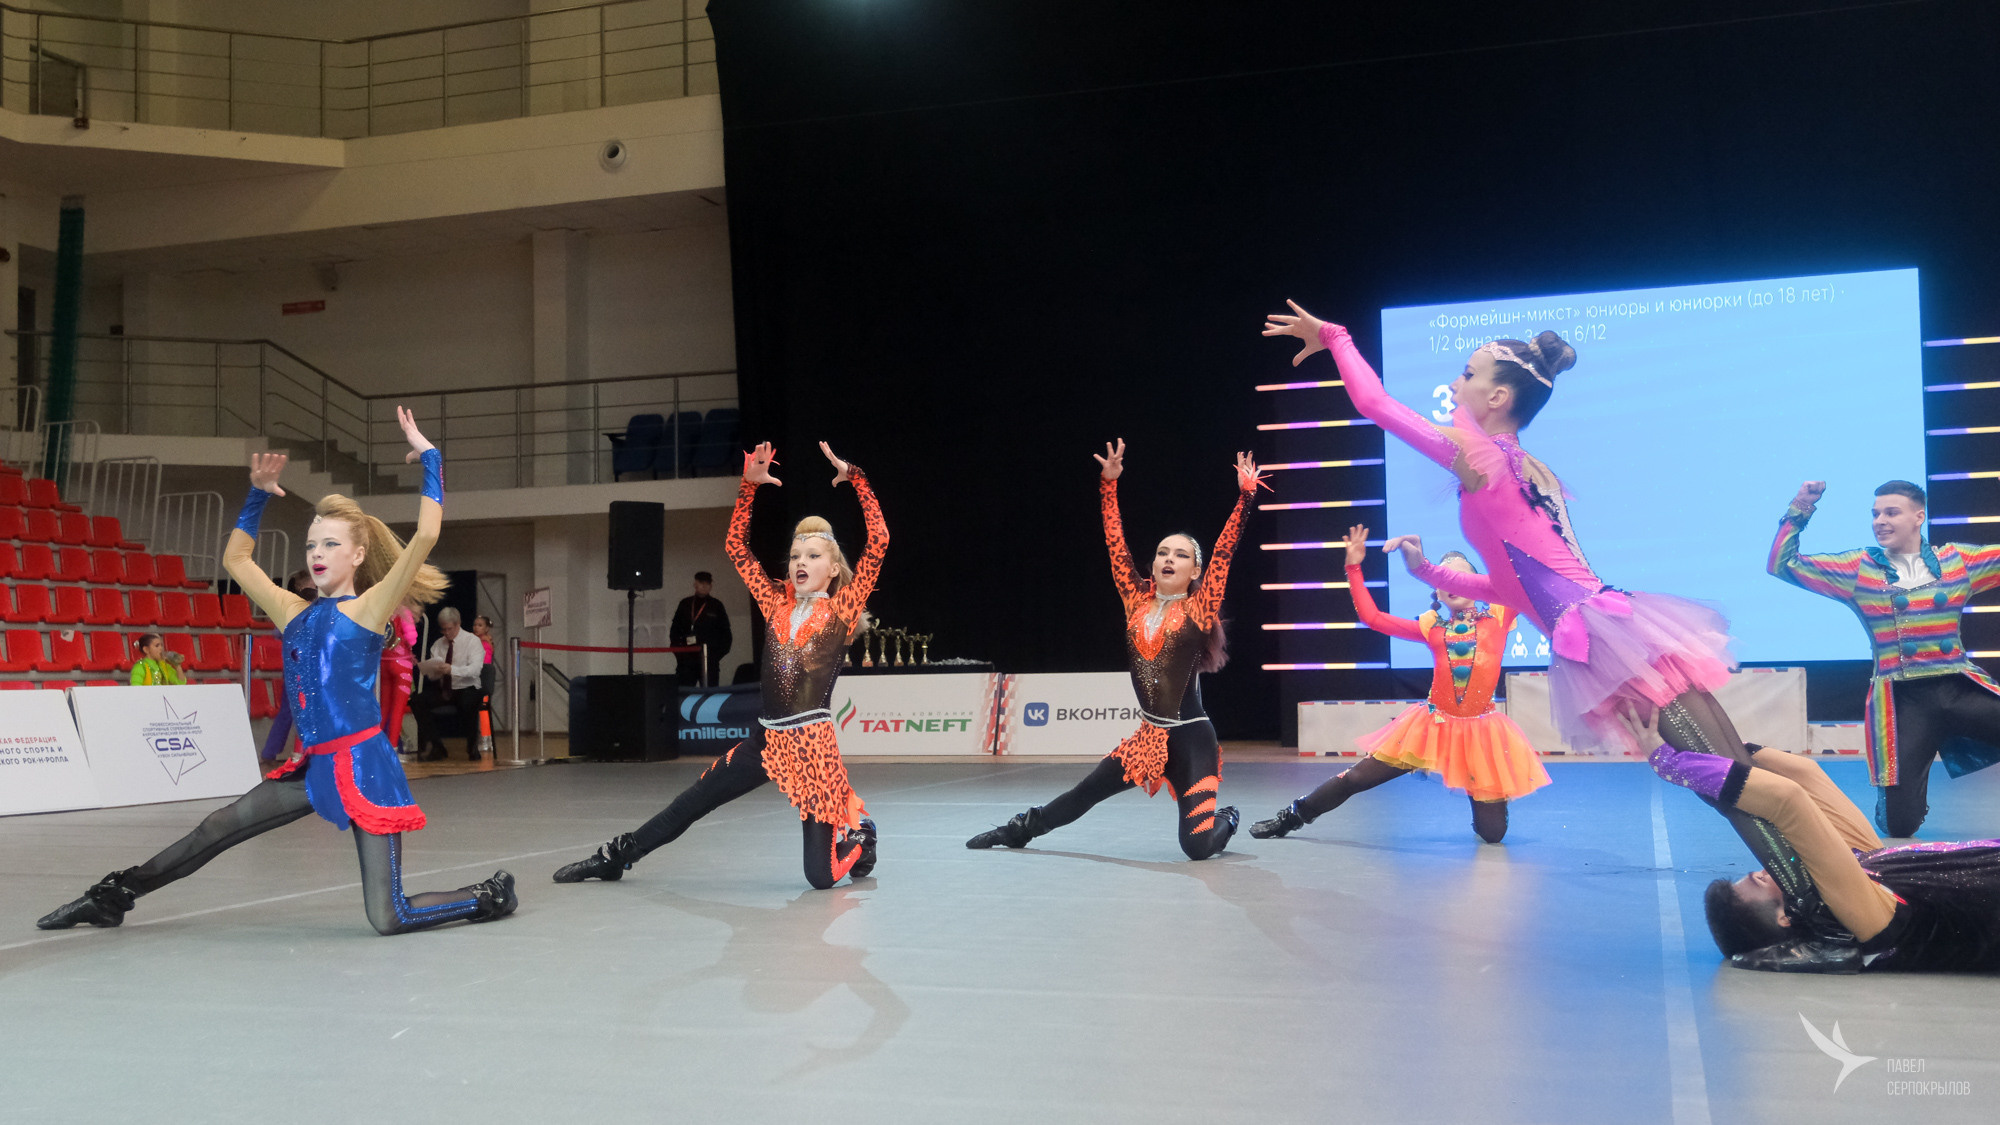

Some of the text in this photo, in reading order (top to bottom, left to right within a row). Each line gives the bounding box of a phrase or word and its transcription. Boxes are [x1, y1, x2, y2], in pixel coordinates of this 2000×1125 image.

[1429, 283, 1835, 330] «Формейшн-микст» юниоры и юниорки (до 18 лет)
[1429, 335, 1449, 354] 1/2
[1574, 323, 1606, 343] 6/12
[859, 719, 972, 733] TATNEFT
[14, 736, 57, 744] ФЕДЕРАЦИЯ
[155, 737, 196, 752] CSA
[24, 746, 55, 754] СПОРТА
